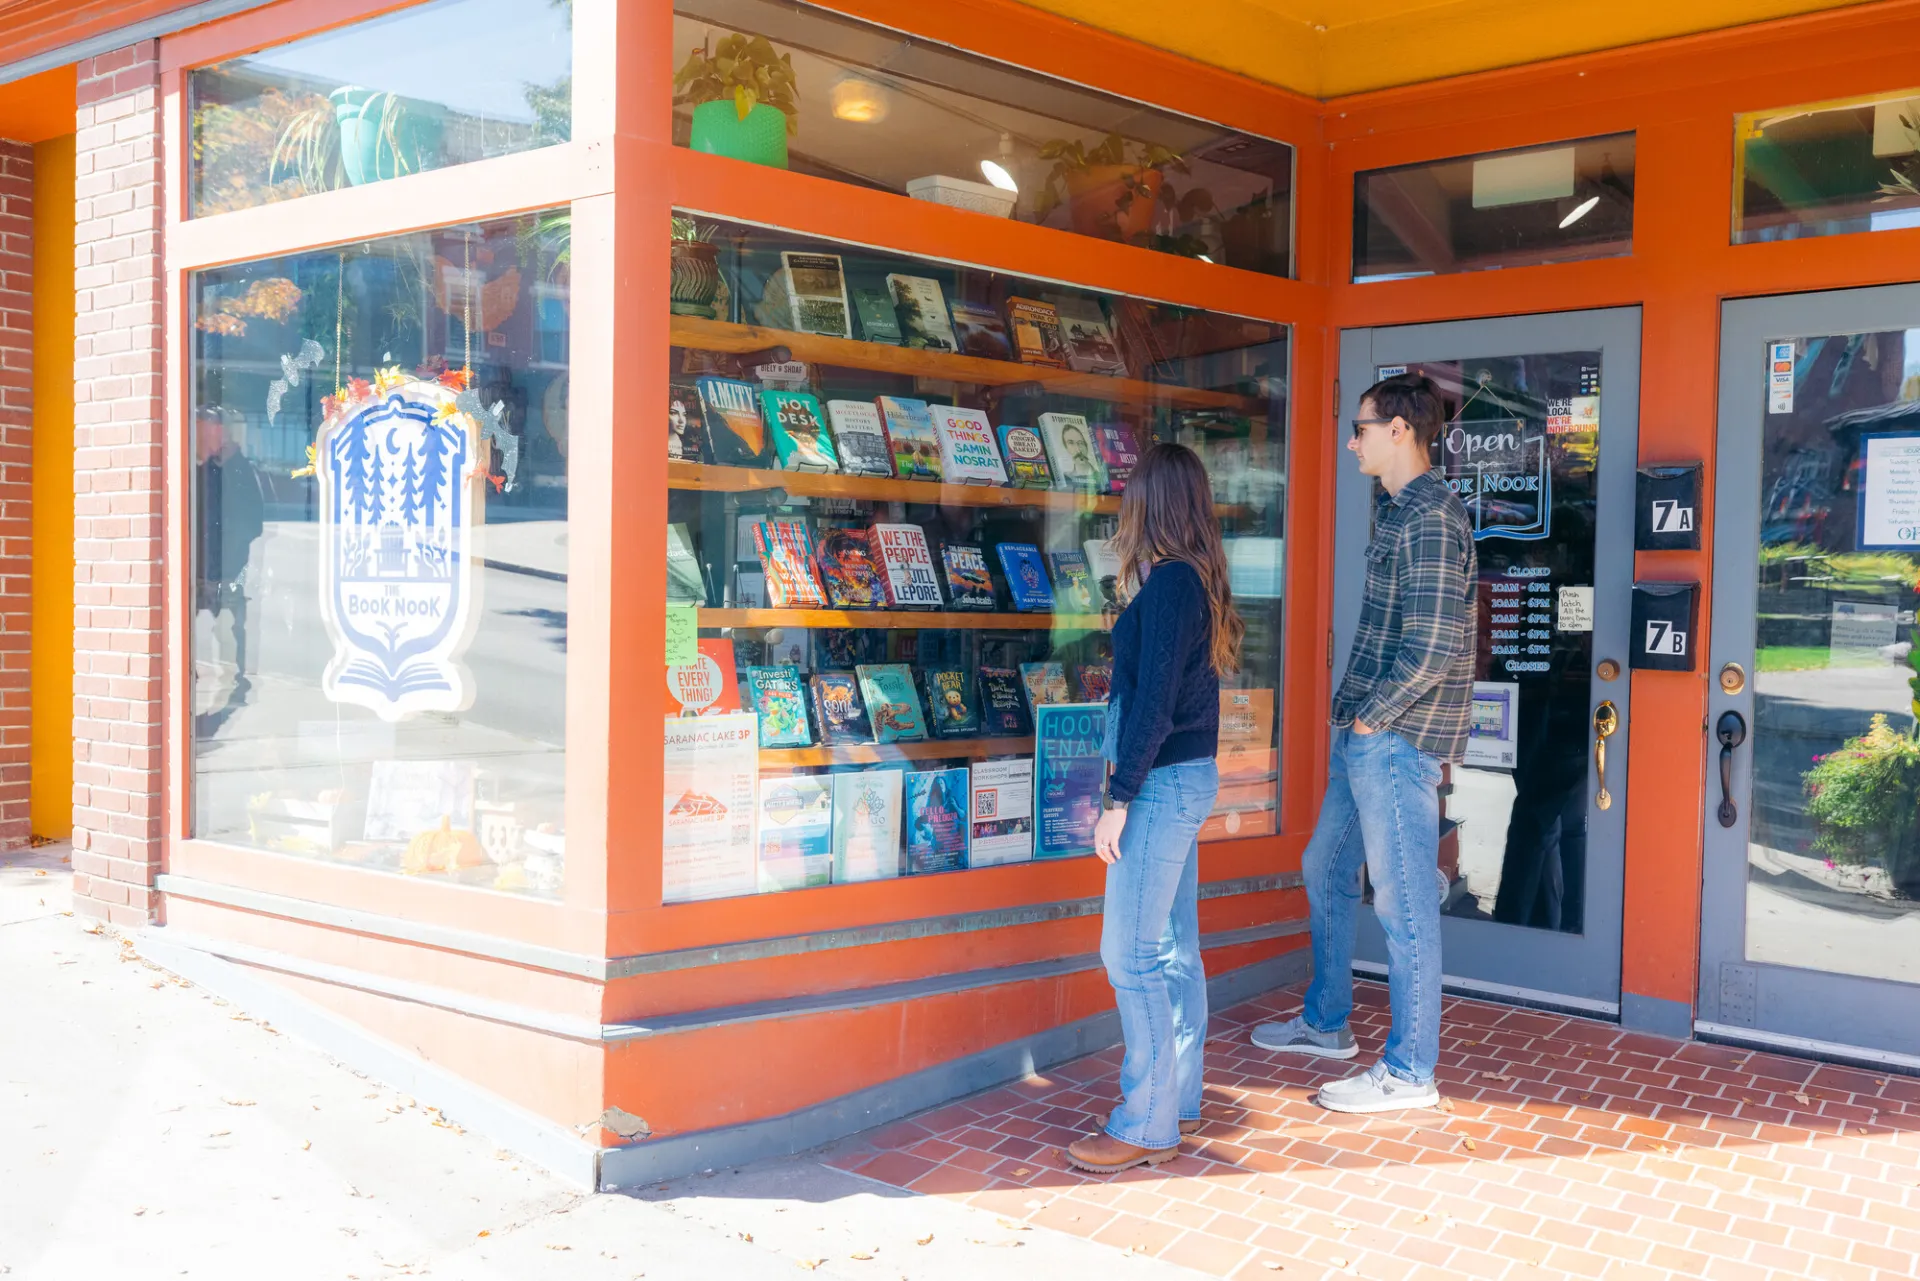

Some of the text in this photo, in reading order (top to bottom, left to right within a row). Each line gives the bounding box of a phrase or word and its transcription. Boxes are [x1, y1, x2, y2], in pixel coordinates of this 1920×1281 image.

[1016, 303, 1055, 317] ADIRONDACK
[1040, 322, 1057, 331] GOLD
[1381, 368, 1404, 376] THANK
[707, 380, 756, 413] AMITY
[1548, 398, 1572, 407] WE'RE
[776, 397, 811, 412] HOT
[1547, 407, 1572, 416] LOCAL
[776, 411, 821, 427] DESK
[845, 417, 871, 425] HISTORY
[947, 418, 983, 431] GOOD
[1546, 416, 1572, 425] WE'RE
[1546, 424, 1598, 434] INDIEBOUND
[946, 430, 990, 443] THINGS
[955, 443, 992, 455] SAMIN
[1446, 428, 1520, 461] Open
[953, 455, 1000, 468] NOSRAT
[880, 530, 925, 547] WE THE
[885, 547, 930, 564] PEOPLE
[950, 552, 986, 571] PEACE
[912, 569, 935, 584] JILL
[384, 585, 400, 596] THE
[1527, 582, 1551, 592] 6PM
[895, 585, 940, 602] LEPORE
[962, 594, 976, 603] John
[1527, 598, 1551, 608] 6PM
[1527, 613, 1551, 623] 6PM
[1527, 629, 1551, 639] 6PM
[1527, 644, 1551, 655] 6PM
[678, 672, 710, 687] EVERY
[759, 669, 792, 679] Investi
[935, 671, 965, 684] POCKET
[942, 680, 963, 691] BEAR
[680, 688, 713, 702] THING!
[1045, 715, 1104, 737] HOOT
[664, 729, 751, 745] SARANAC LAKE 3P
[974, 766, 1008, 775] CLASSROOM
[1044, 760, 1072, 780] NY
[974, 773, 1008, 781] WORKSHOPS
[920, 805, 945, 815] CELLO
[668, 818, 698, 827] SARANAC
[716, 814, 725, 822] 3P
